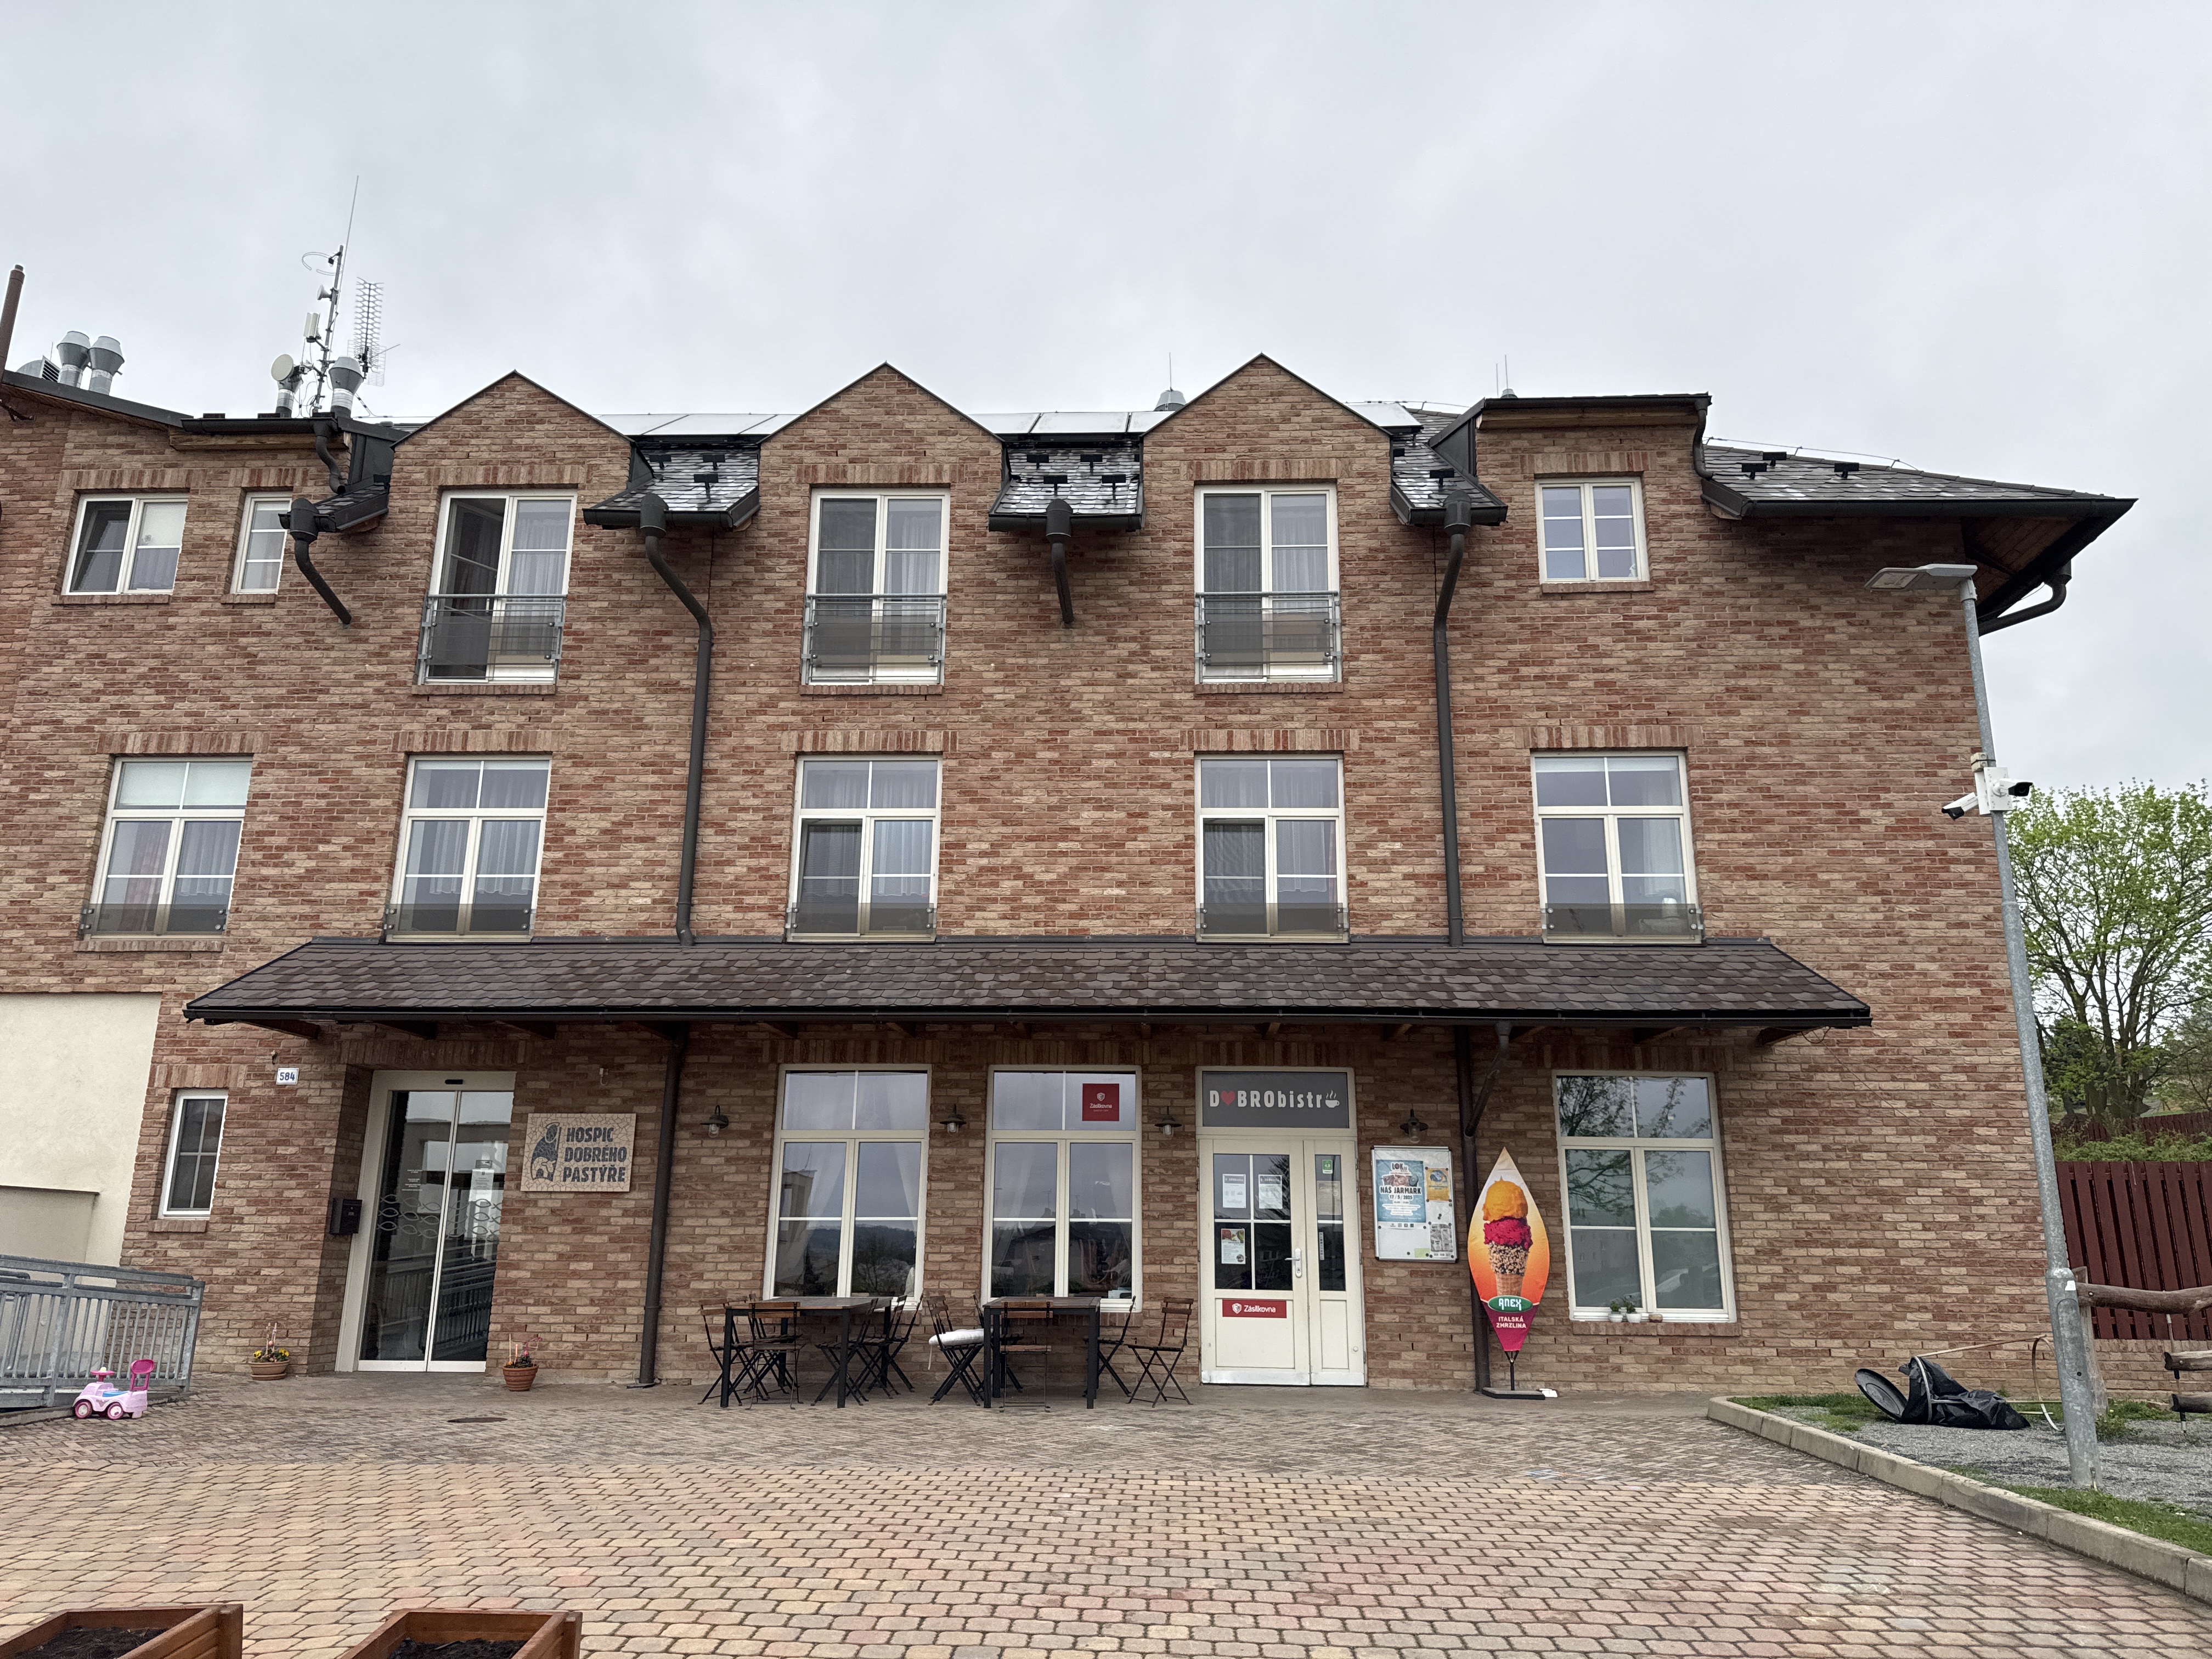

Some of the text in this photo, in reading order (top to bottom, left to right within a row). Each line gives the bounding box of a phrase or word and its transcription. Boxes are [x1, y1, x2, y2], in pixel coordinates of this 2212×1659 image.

[280, 1072, 295, 1081] 584
[566, 1127, 614, 1142] HOSPIC
[565, 1145, 627, 1163] DOBRÉHO
[562, 1164, 626, 1182] PASTÝŘE
[1244, 1305, 1276, 1313] Zásilkovna
[1498, 1298, 1522, 1311] ANEX
